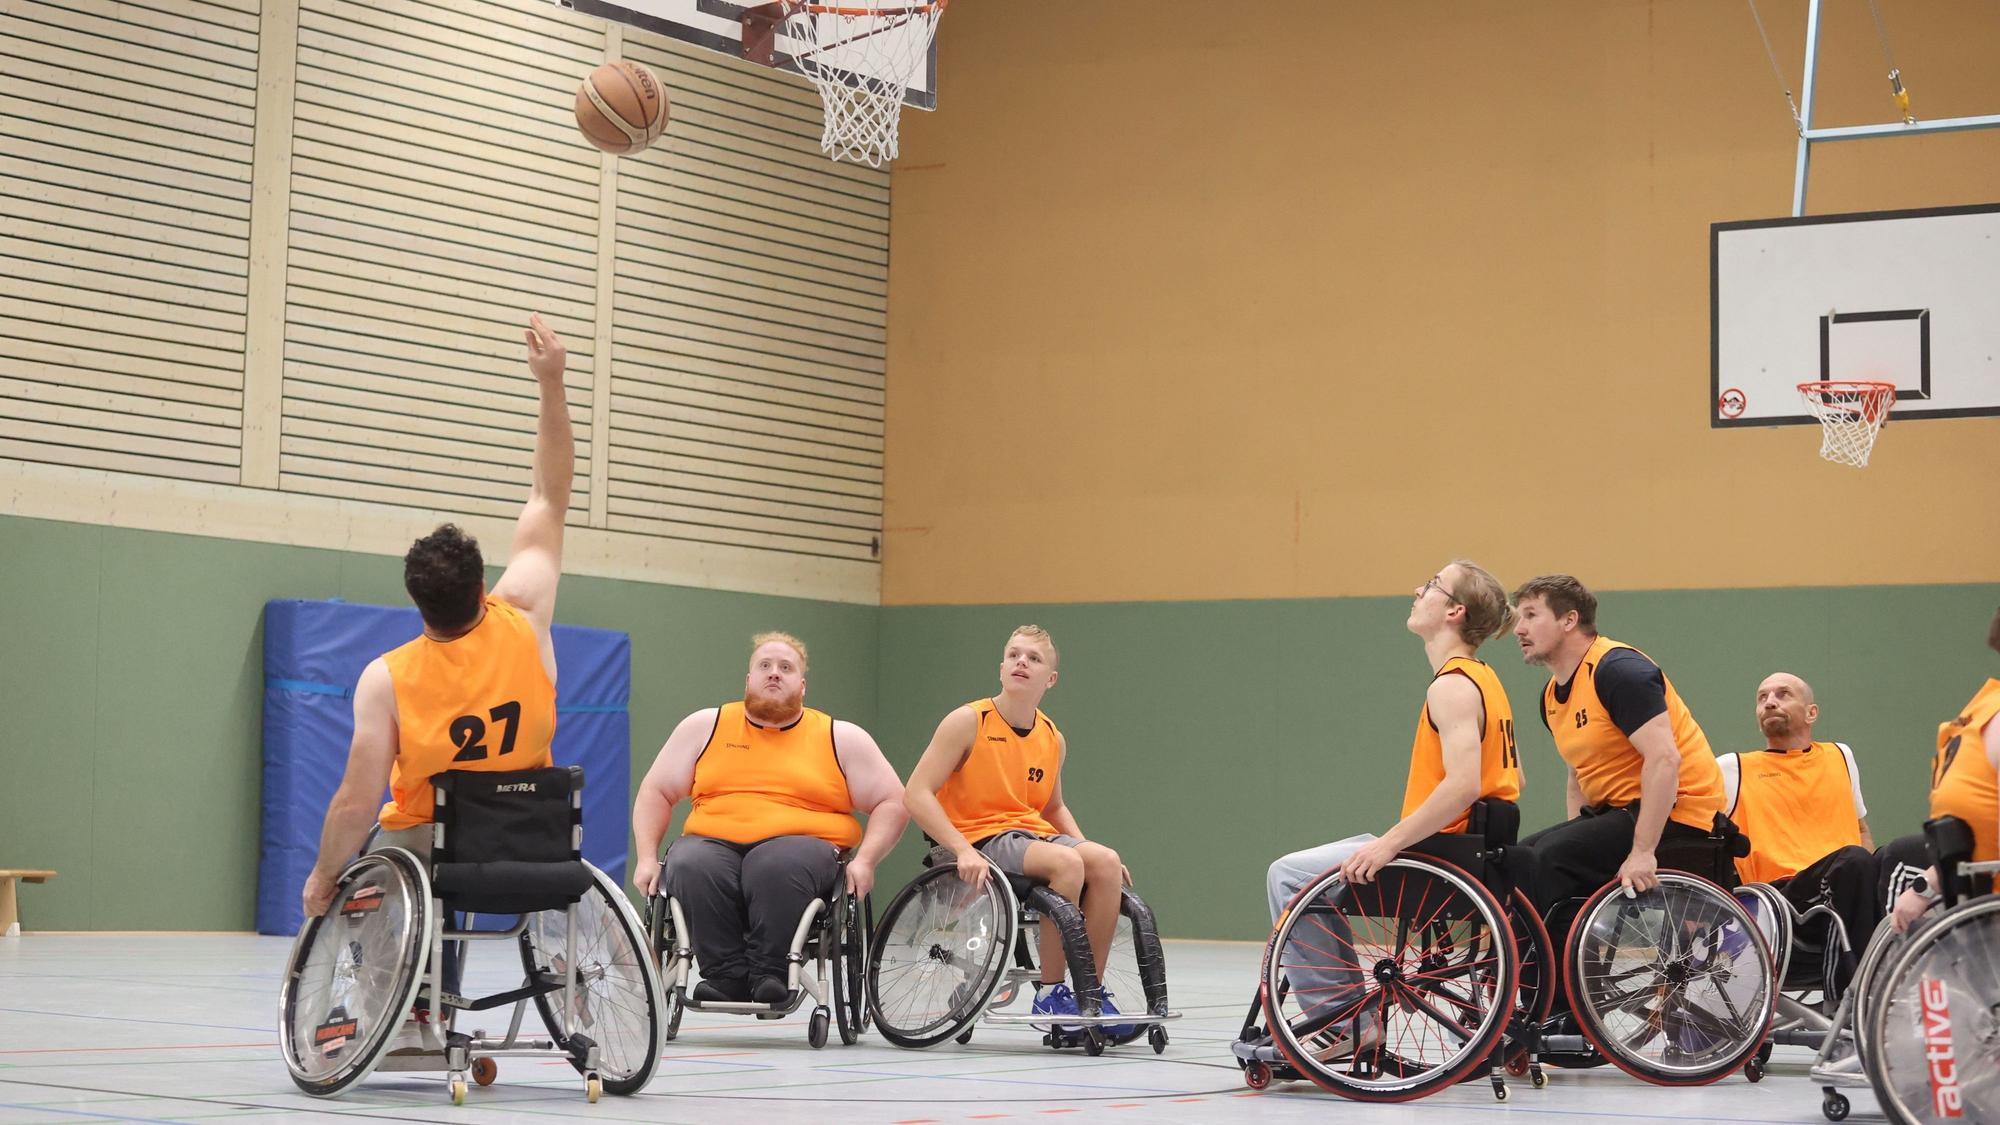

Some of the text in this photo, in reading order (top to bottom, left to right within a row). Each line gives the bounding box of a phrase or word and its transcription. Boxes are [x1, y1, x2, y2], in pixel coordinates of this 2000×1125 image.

[449, 701, 521, 762] 27
[1575, 708, 1588, 729] 25
[1499, 719, 1518, 769] 14
[1027, 767, 1044, 783] 29
[1923, 979, 1962, 1118] active
